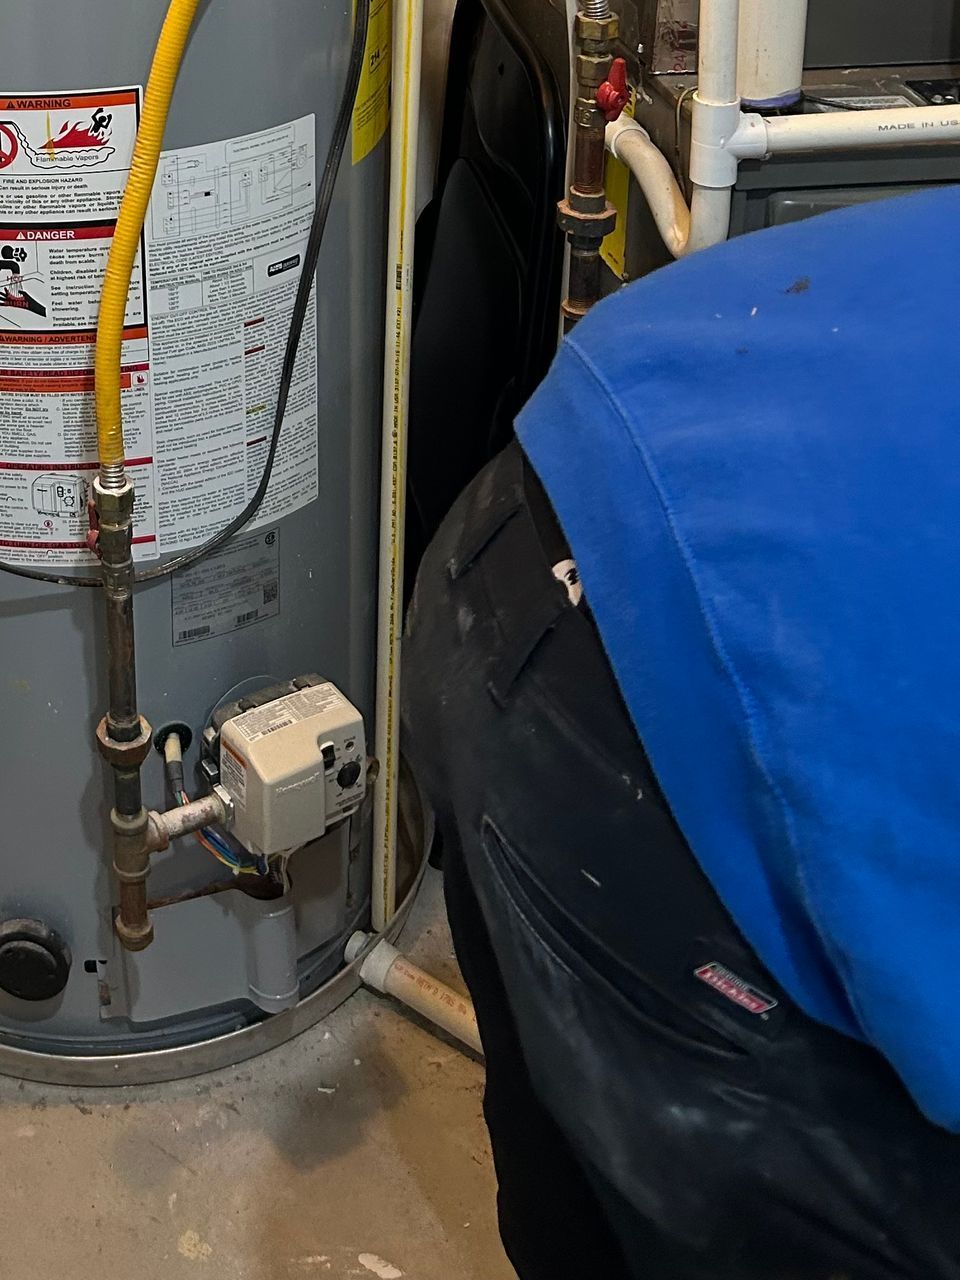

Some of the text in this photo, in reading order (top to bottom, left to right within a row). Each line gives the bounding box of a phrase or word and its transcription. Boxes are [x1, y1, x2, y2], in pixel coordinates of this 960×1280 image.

[16, 98, 72, 109] WARNING
[878, 124, 916, 132] MADE
[36, 154, 99, 164] Flammable Vapors
[27, 230, 75, 240] DANGER
[56, 274, 76, 282] highest
[4, 334, 41, 343] WARNING
